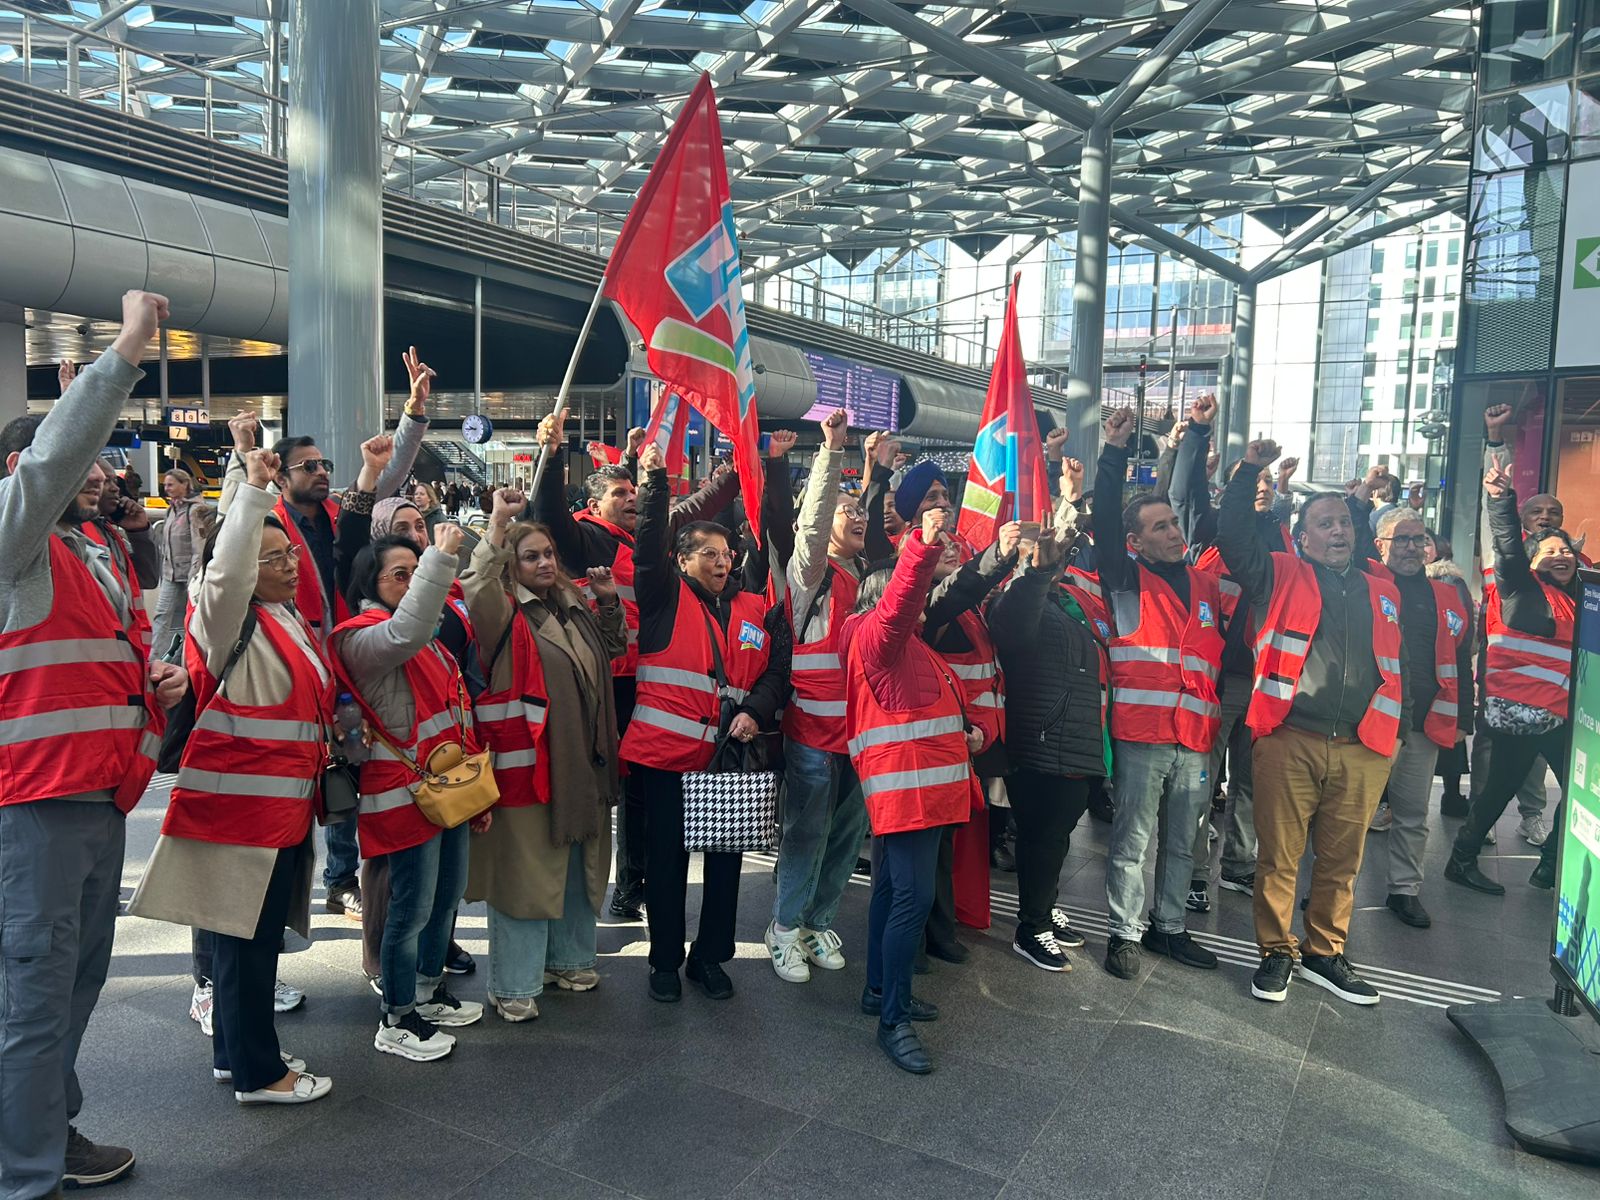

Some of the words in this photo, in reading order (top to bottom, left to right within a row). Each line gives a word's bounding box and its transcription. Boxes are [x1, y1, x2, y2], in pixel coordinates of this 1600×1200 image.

[175, 428, 181, 437] 7
[741, 625, 763, 645] FNV
[1578, 707, 1594, 730] Onze
